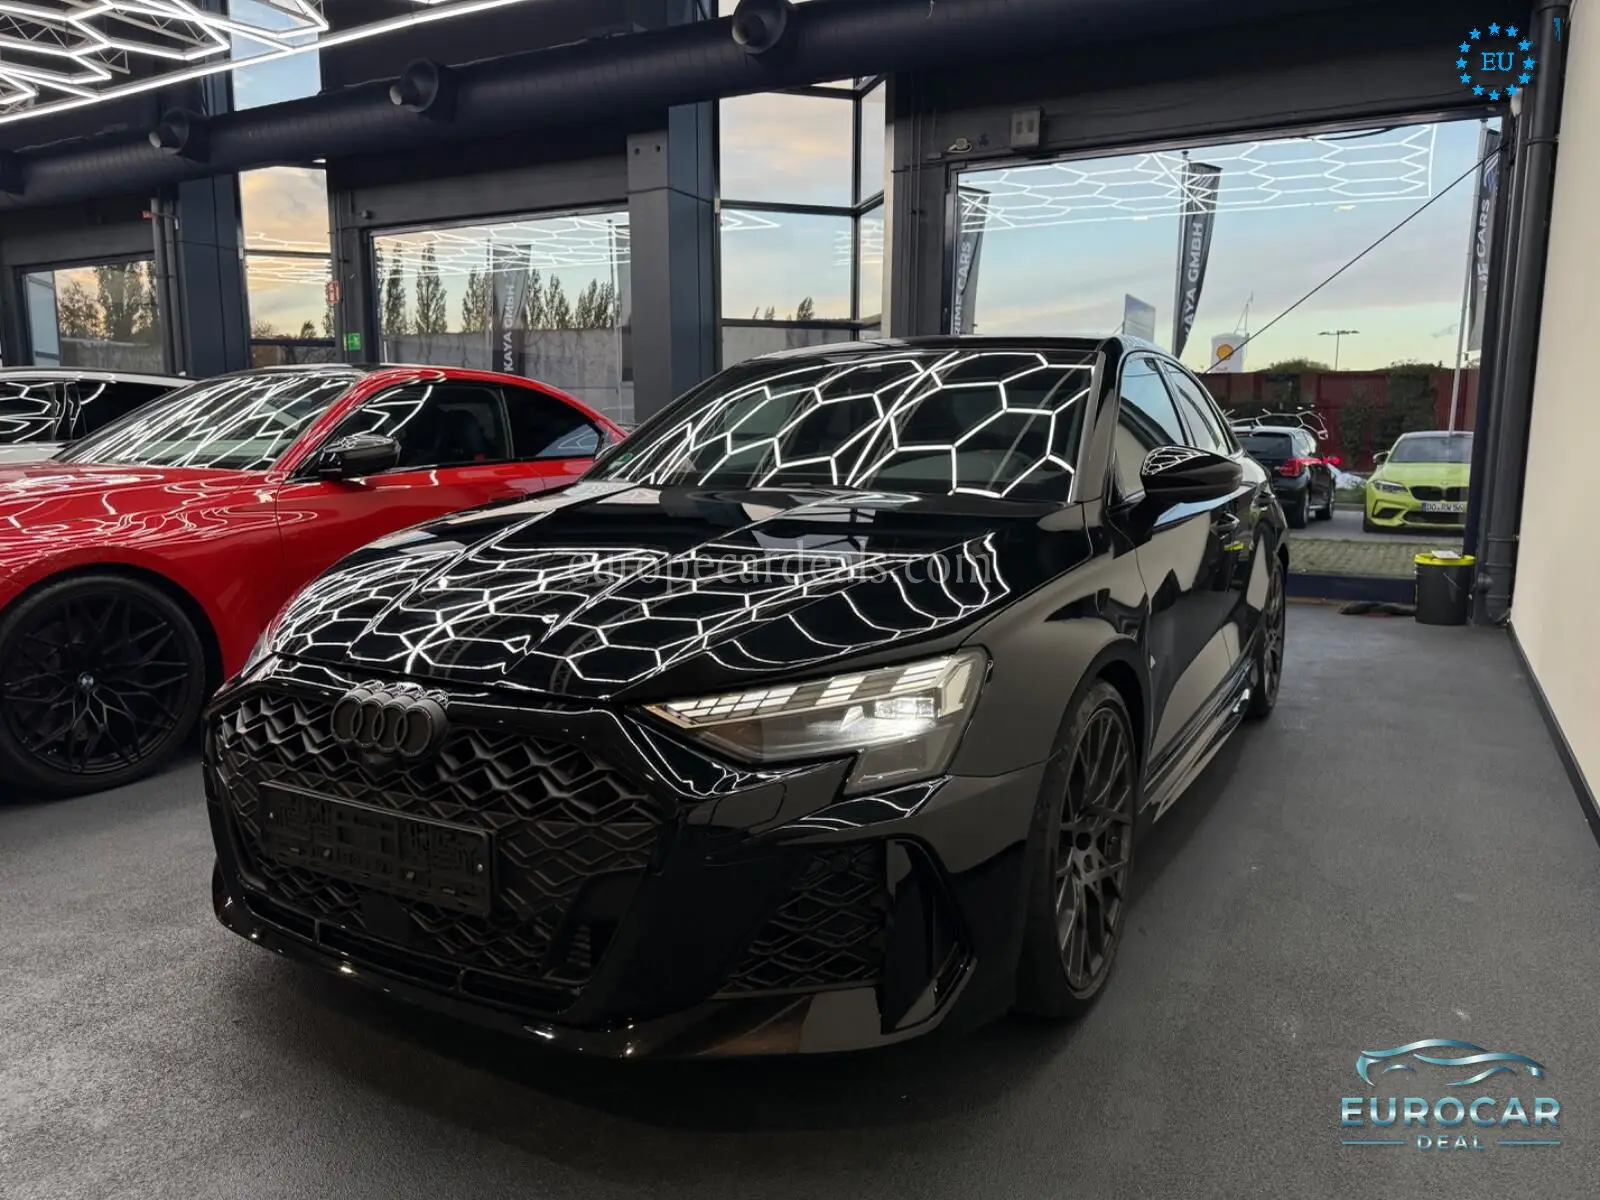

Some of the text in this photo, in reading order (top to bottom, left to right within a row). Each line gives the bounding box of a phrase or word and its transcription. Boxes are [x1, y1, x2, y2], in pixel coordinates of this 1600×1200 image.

[1188, 222, 1204, 283] GMBH
[1476, 199, 1490, 259] CARS
[957, 241, 972, 291] CARS
[503, 284, 516, 372] KAYA GMBH
